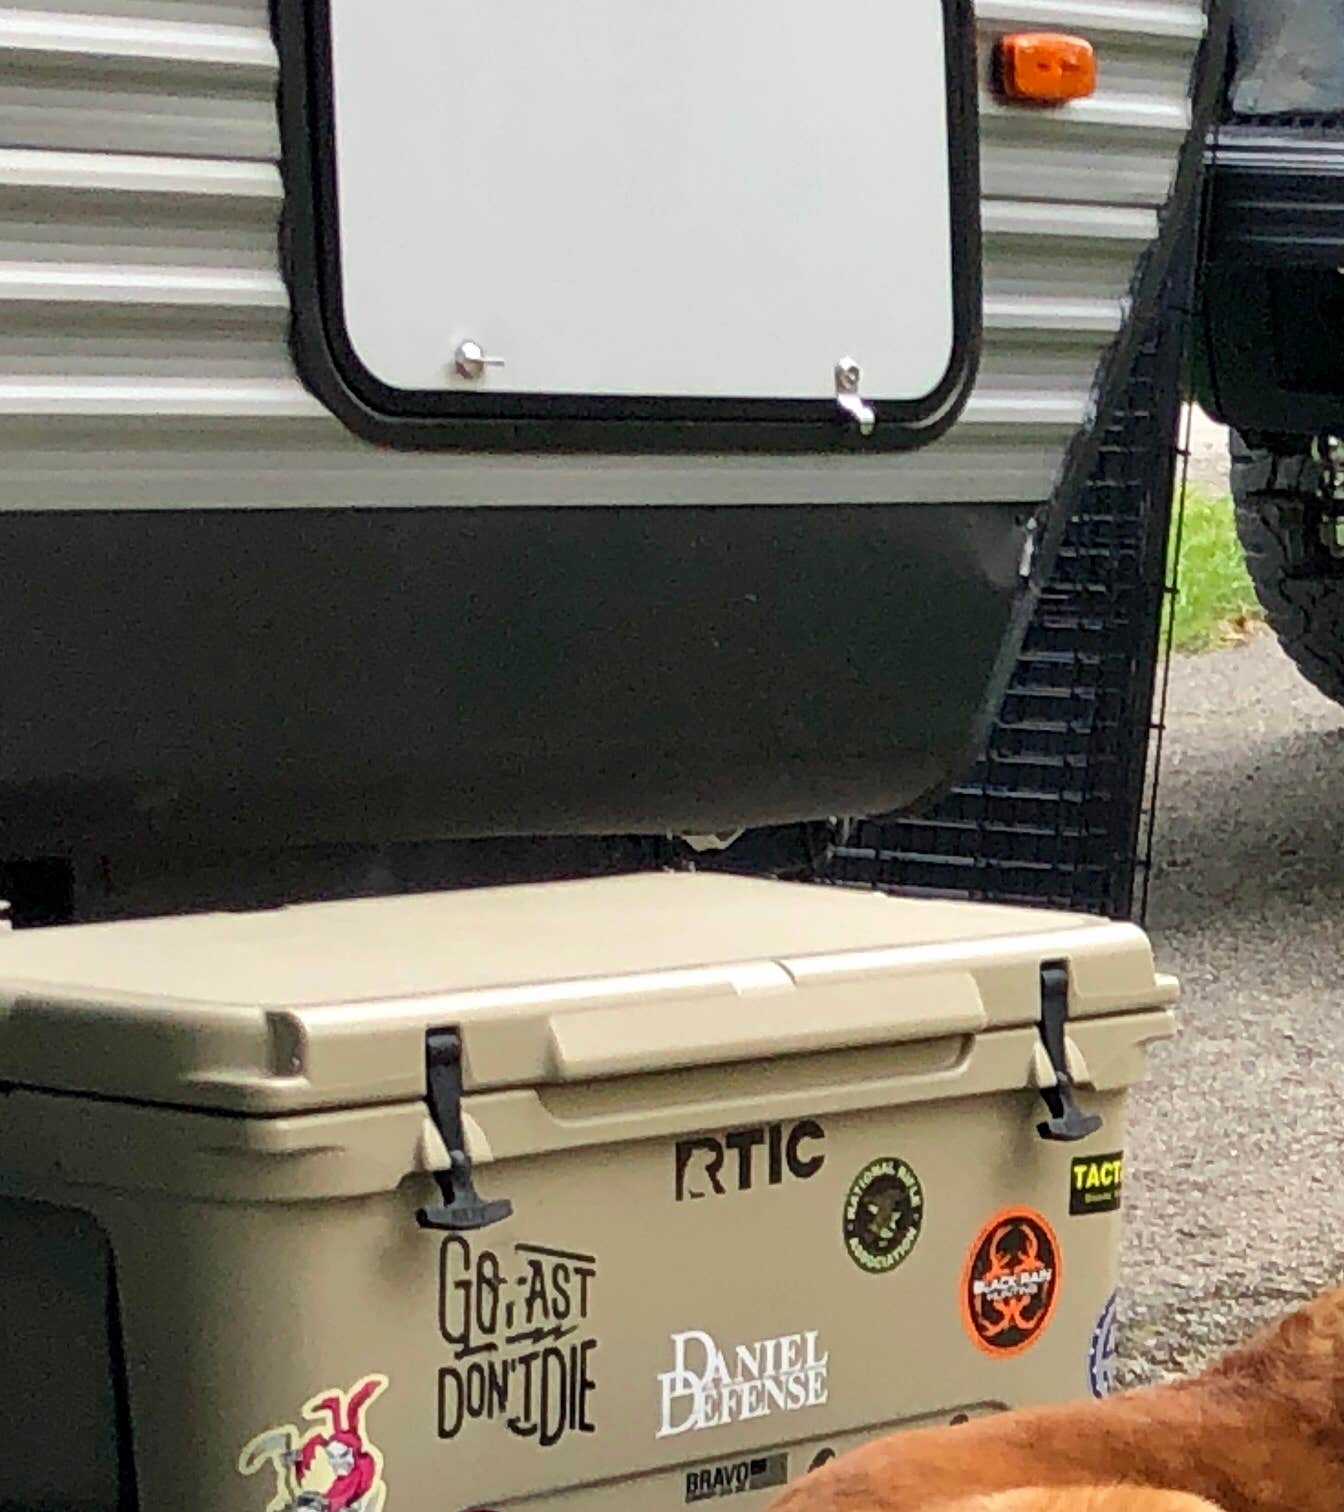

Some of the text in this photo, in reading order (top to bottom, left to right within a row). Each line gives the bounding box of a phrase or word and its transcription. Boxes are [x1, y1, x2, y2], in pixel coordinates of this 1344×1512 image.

[675, 1119, 825, 1201] RTIC
[438, 1235, 499, 1360] GO
[437, 1339, 597, 1447] DON'T DIE
[670, 1330, 829, 1393] DANIEL
[655, 1367, 829, 1440] DEFENSE
[686, 1461, 749, 1497] BRAVO
